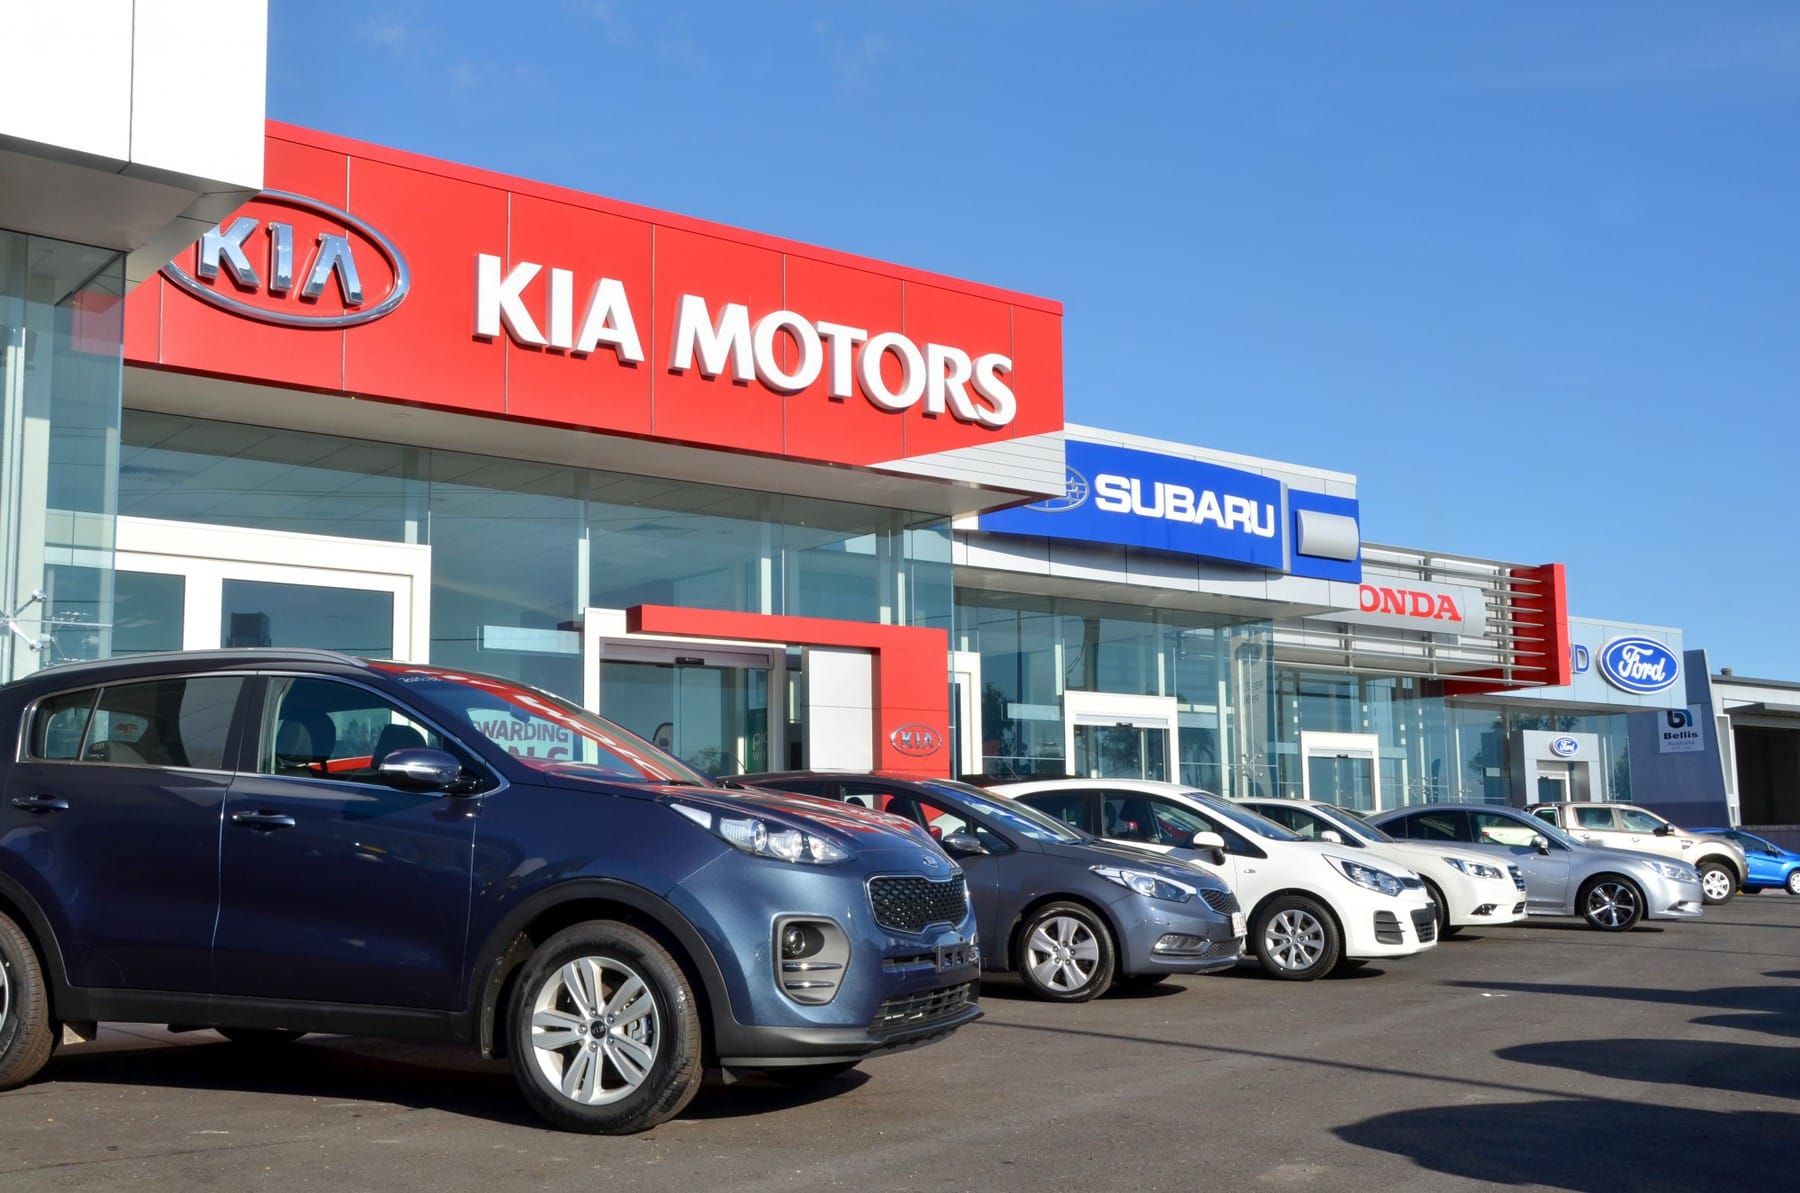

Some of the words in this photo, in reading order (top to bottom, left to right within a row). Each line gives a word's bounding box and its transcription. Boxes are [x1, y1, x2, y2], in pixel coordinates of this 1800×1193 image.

[198, 216, 364, 306] KIA
[474, 252, 645, 362] KIA
[669, 293, 1017, 427] MOTORS
[1094, 473, 1275, 538] SUBARU
[1359, 584, 1462, 622] ONDA
[1618, 645, 1666, 682] Ford
[473, 719, 569, 743] WARDING
[900, 731, 935, 750] KIA
[1663, 731, 1698, 740] Bellis
